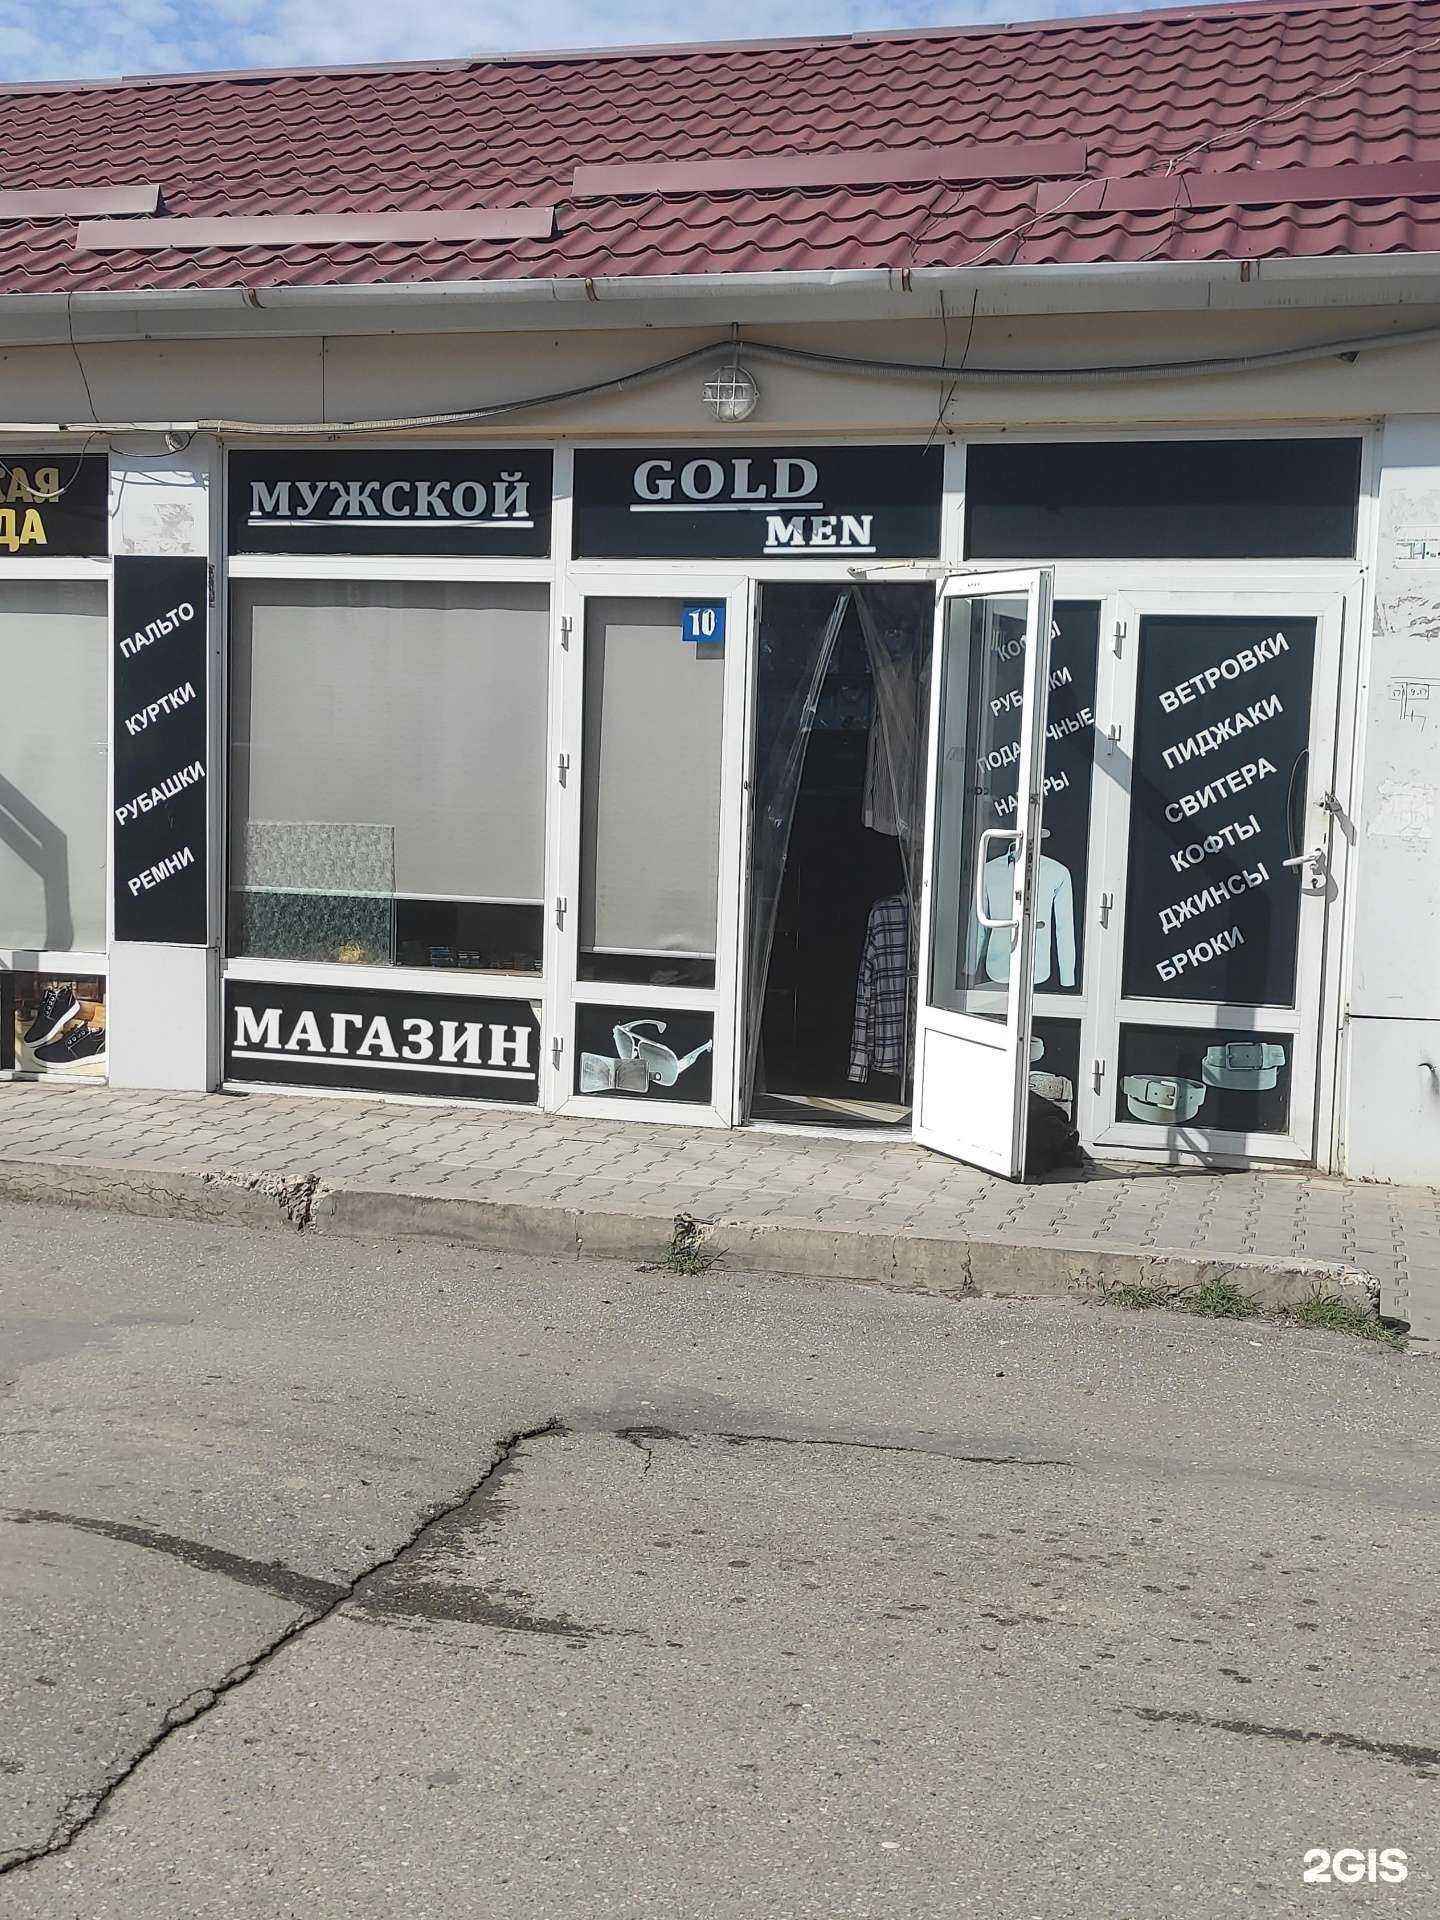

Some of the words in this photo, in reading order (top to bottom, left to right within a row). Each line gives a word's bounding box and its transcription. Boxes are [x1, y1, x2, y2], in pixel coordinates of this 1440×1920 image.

[0, 467, 59, 503] АЯ
[250, 472, 530, 517] МУЖСКОЙ
[633, 458, 819, 500] GOLD
[765, 515, 874, 546] MEN
[119, 602, 195, 658] ПАЛЬТО
[687, 607, 717, 638] 10
[997, 620, 1062, 663] КОЫ
[990, 666, 1072, 717] РУБКИ
[1158, 632, 1290, 713] ВЕТРОВКИ
[125, 681, 196, 735] КУРТКИ
[1162, 694, 1283, 769] ПИДЖАКИ
[976, 708, 1095, 774] ПОДАЧНЫЕ
[115, 760, 206, 826] РУБАШКИ
[994, 771, 1070, 817] НАРЫ
[1165, 757, 1277, 823] СВИТЕРА
[1170, 814, 1262, 872] КОФТЫ
[128, 846, 195, 896] РЕМНИ
[1158, 862, 1270, 934] ДЖИНСЫ
[1156, 926, 1245, 981] БРЮКИ
[233, 1006, 532, 1068] МАГАЗИН
